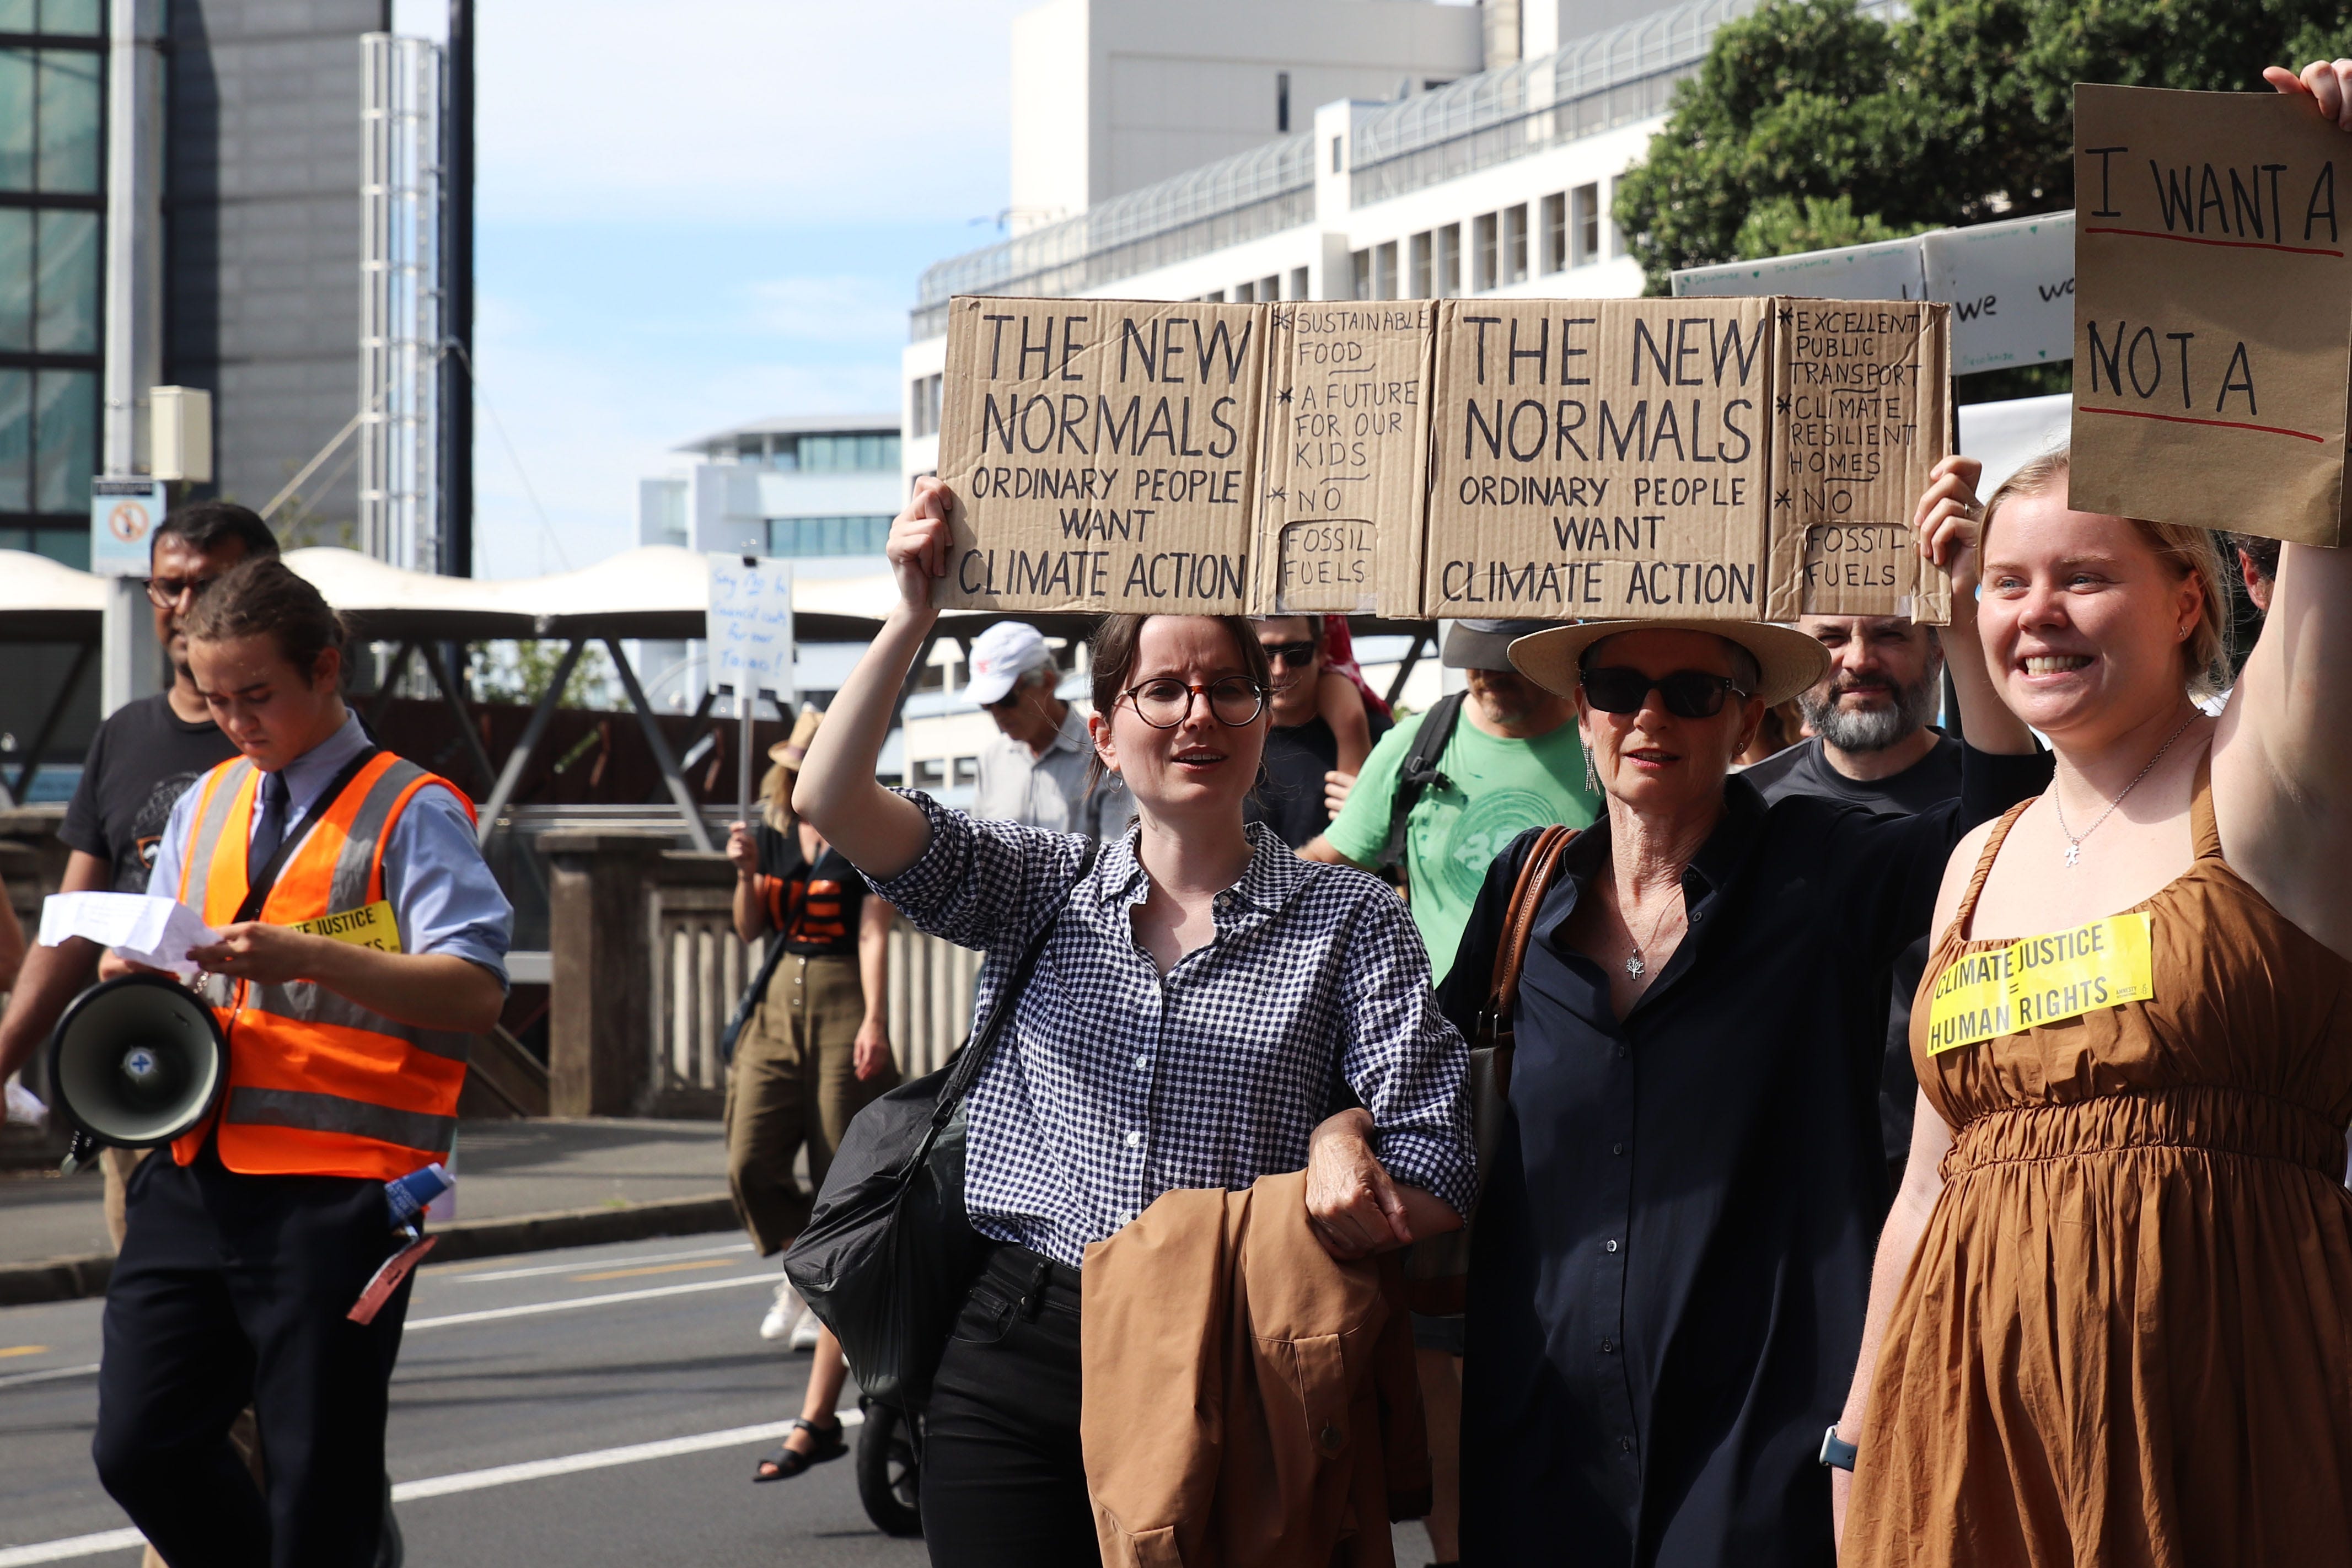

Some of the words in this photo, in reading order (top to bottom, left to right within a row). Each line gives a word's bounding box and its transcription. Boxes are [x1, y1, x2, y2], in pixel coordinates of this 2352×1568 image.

[2085, 147, 2128, 217] I
[2150, 159, 2287, 243] WANT
[2304, 161, 2338, 243] A
[1297, 309, 1429, 333] SUSTAINABLE
[1956, 296, 1996, 322] we
[1797, 312, 1920, 334] EXCELLENT
[984, 315, 1087, 381] THE
[1120, 318, 1252, 384] NEW
[1299, 342, 1362, 366] FOOD
[1463, 316, 1596, 385] THE
[1632, 318, 1765, 388] NEW
[1797, 336, 1874, 357] PUBLIC
[1789, 362, 1922, 386] TRANSPORT
[2087, 320, 2194, 409] NOT
[2216, 342, 2257, 415] A
[1301, 386, 1317, 410] A
[1327, 380, 1419, 408] FUTURE
[1795, 397, 1902, 420] CLIMATE
[982, 393, 1237, 458] NORMALS
[1296, 414, 1341, 437] FOR
[1355, 413, 1402, 436] OUR
[1465, 398, 1752, 463] NORMALS
[1791, 424, 1916, 447] RESILIENT
[1296, 442, 1366, 469] KIDS
[1790, 452, 1881, 475] HOMES
[973, 467, 1118, 499] ORDINARY
[1135, 469, 1242, 503] PEOPLE
[1460, 476, 1609, 507] ORDINARY
[1635, 477, 1745, 507] PEOPLE
[1299, 488, 1341, 512] NO
[1803, 487, 1852, 513] NO
[1060, 508, 1154, 542] WANT
[1553, 516, 1665, 551] WANT
[1807, 525, 1905, 552] FOSSIL
[1285, 528, 1371, 552] FOSSIL
[959, 549, 1109, 595] CLIMATE
[1123, 552, 1245, 599] ACTION
[1285, 561, 1366, 586] FUELS
[1442, 561, 1603, 603] CLIMATE
[1626, 561, 1755, 604] ACTION
[1805, 561, 1895, 587] FUELS
[317, 907, 375, 936] JUSTICE
[1935, 952, 2013, 1000] CLIMATE
[2018, 924, 2104, 973] JUSTICE
[1931, 1005, 2010, 1051] HUMAN
[2020, 976, 2108, 1025] RIGHTS
